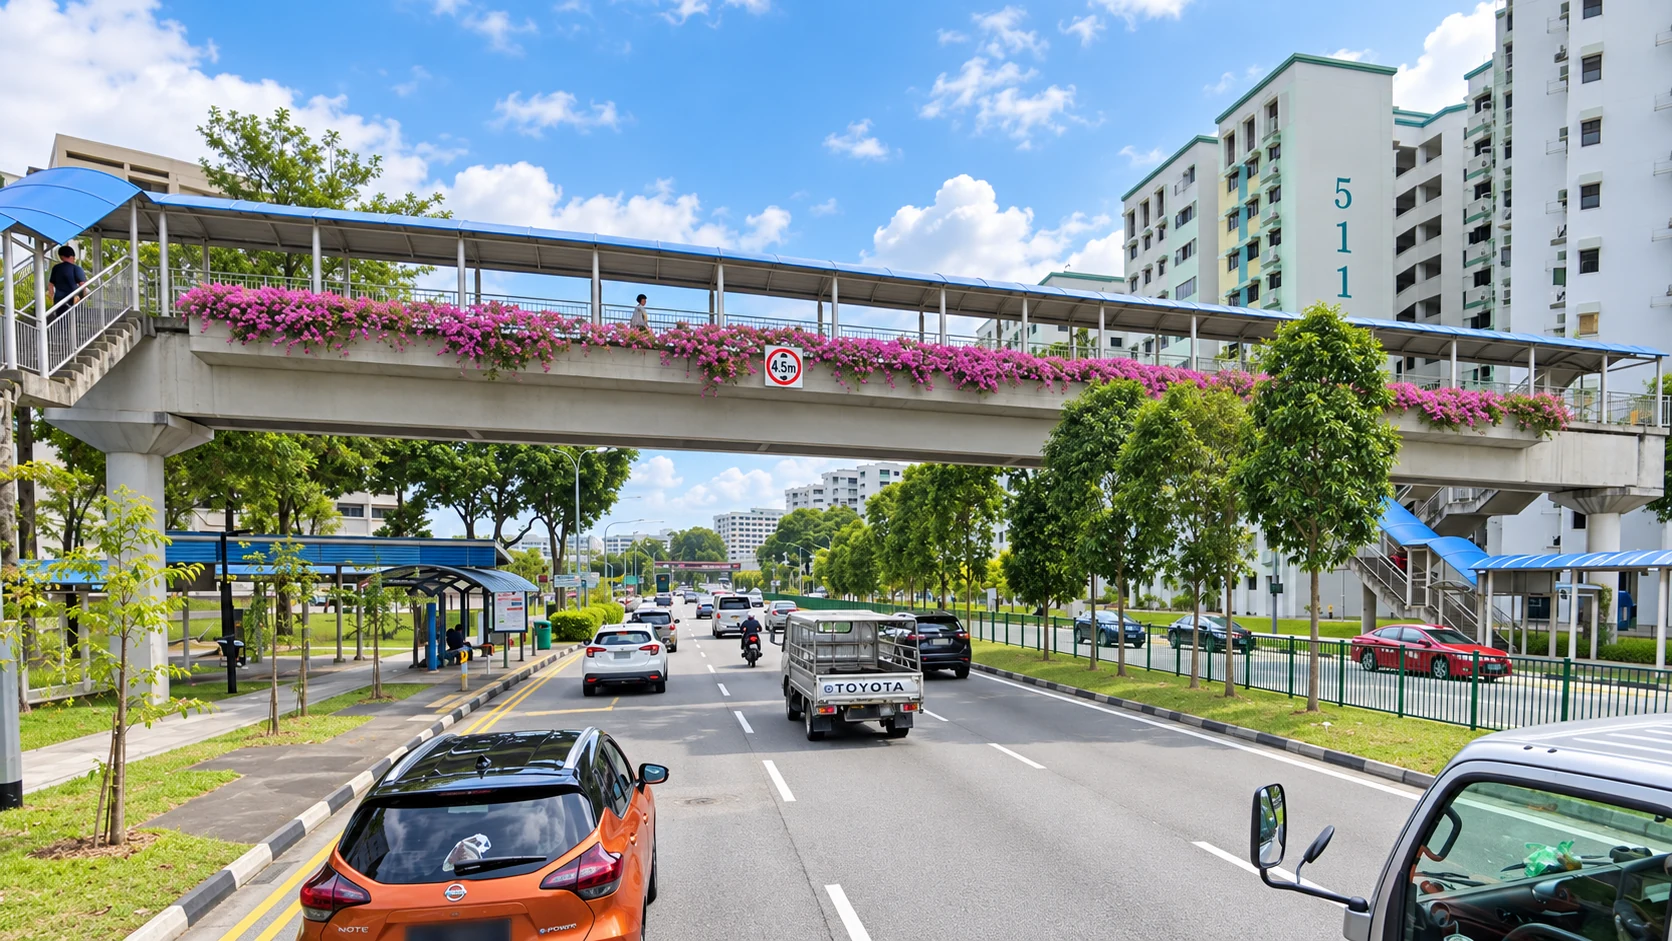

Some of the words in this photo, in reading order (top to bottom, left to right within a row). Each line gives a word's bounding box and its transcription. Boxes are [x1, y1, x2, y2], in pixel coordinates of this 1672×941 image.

[1334, 177, 1352, 299] 511
[771, 359, 797, 374] 4.5m
[835, 682, 904, 693] TOYOTA
